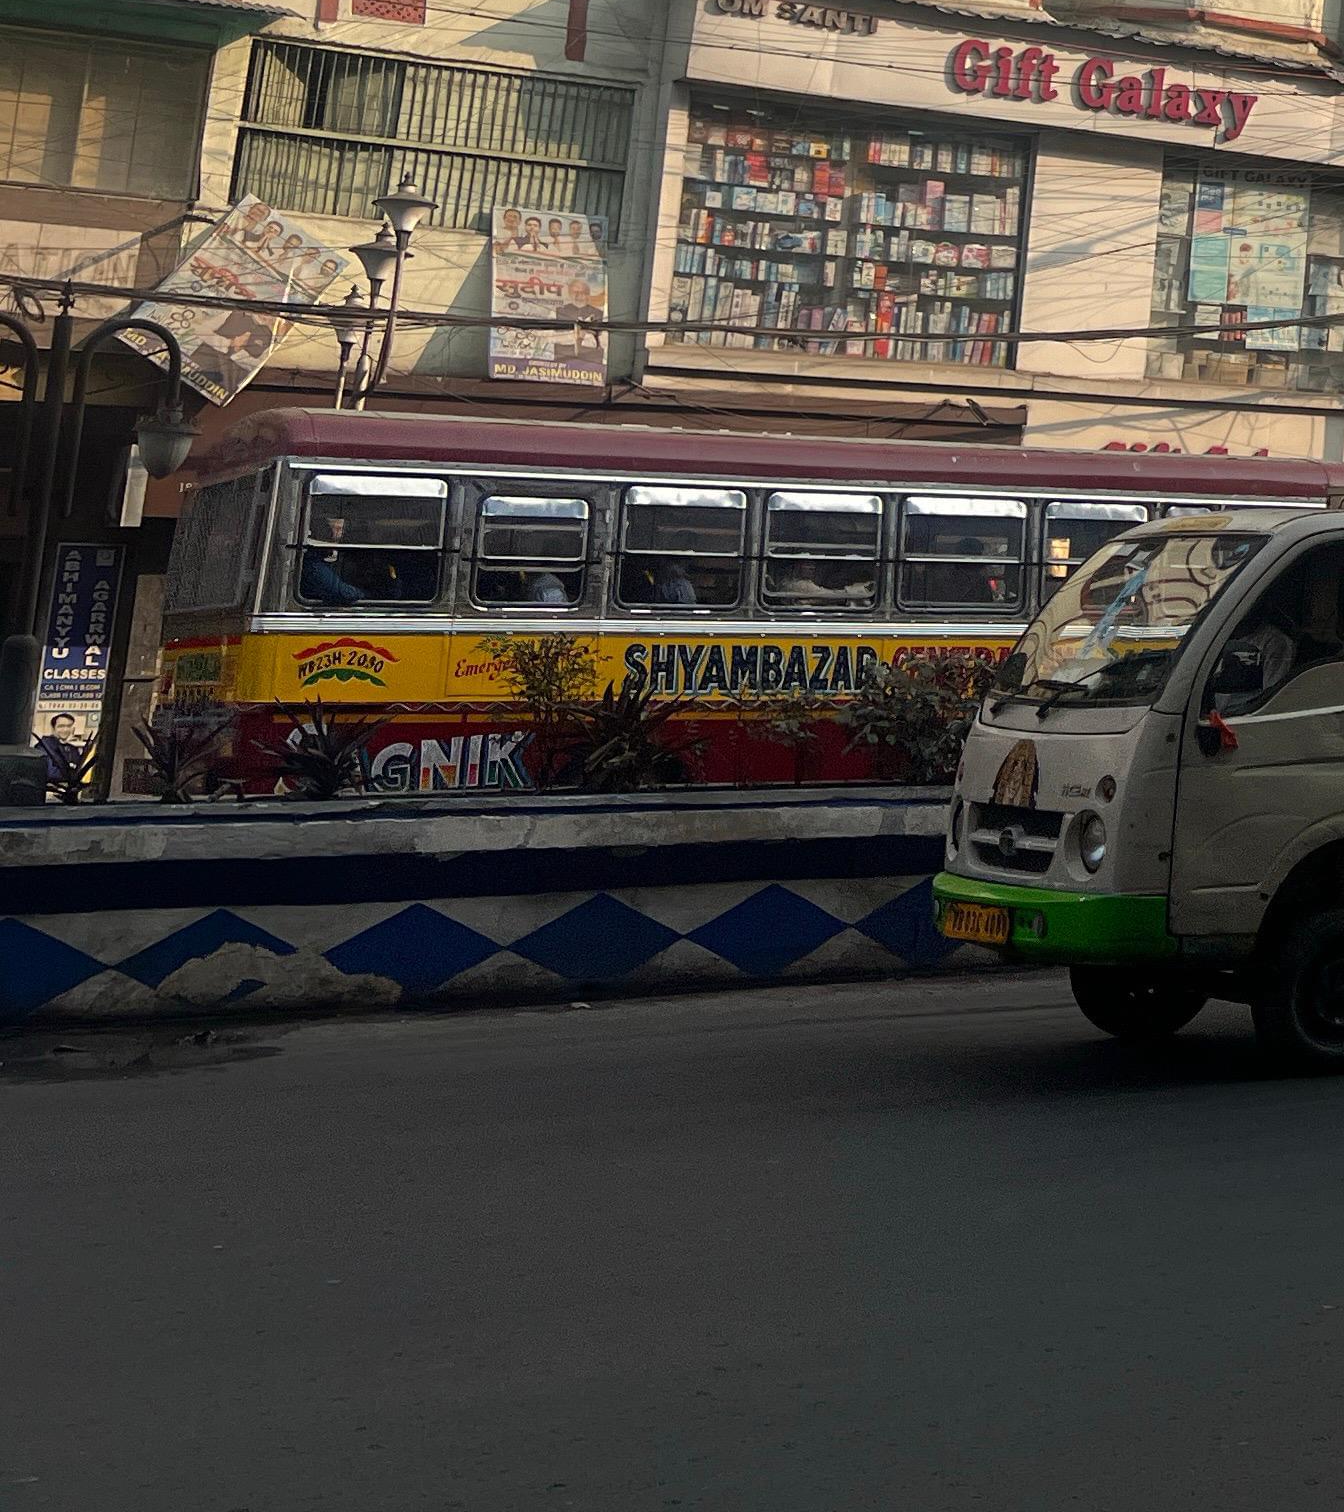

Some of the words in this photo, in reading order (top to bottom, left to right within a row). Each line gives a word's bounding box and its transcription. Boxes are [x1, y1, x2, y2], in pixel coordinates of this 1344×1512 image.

[953, 39, 1060, 103] Gift
[1078, 58, 1258, 141] Galaxy
[1203, 166, 1240, 181] GIFT
[1243, 170, 1308, 188] GALAXY
[43, 668, 106, 680] CLASSES
[624, 643, 882, 695] SHYAMBAZAR
